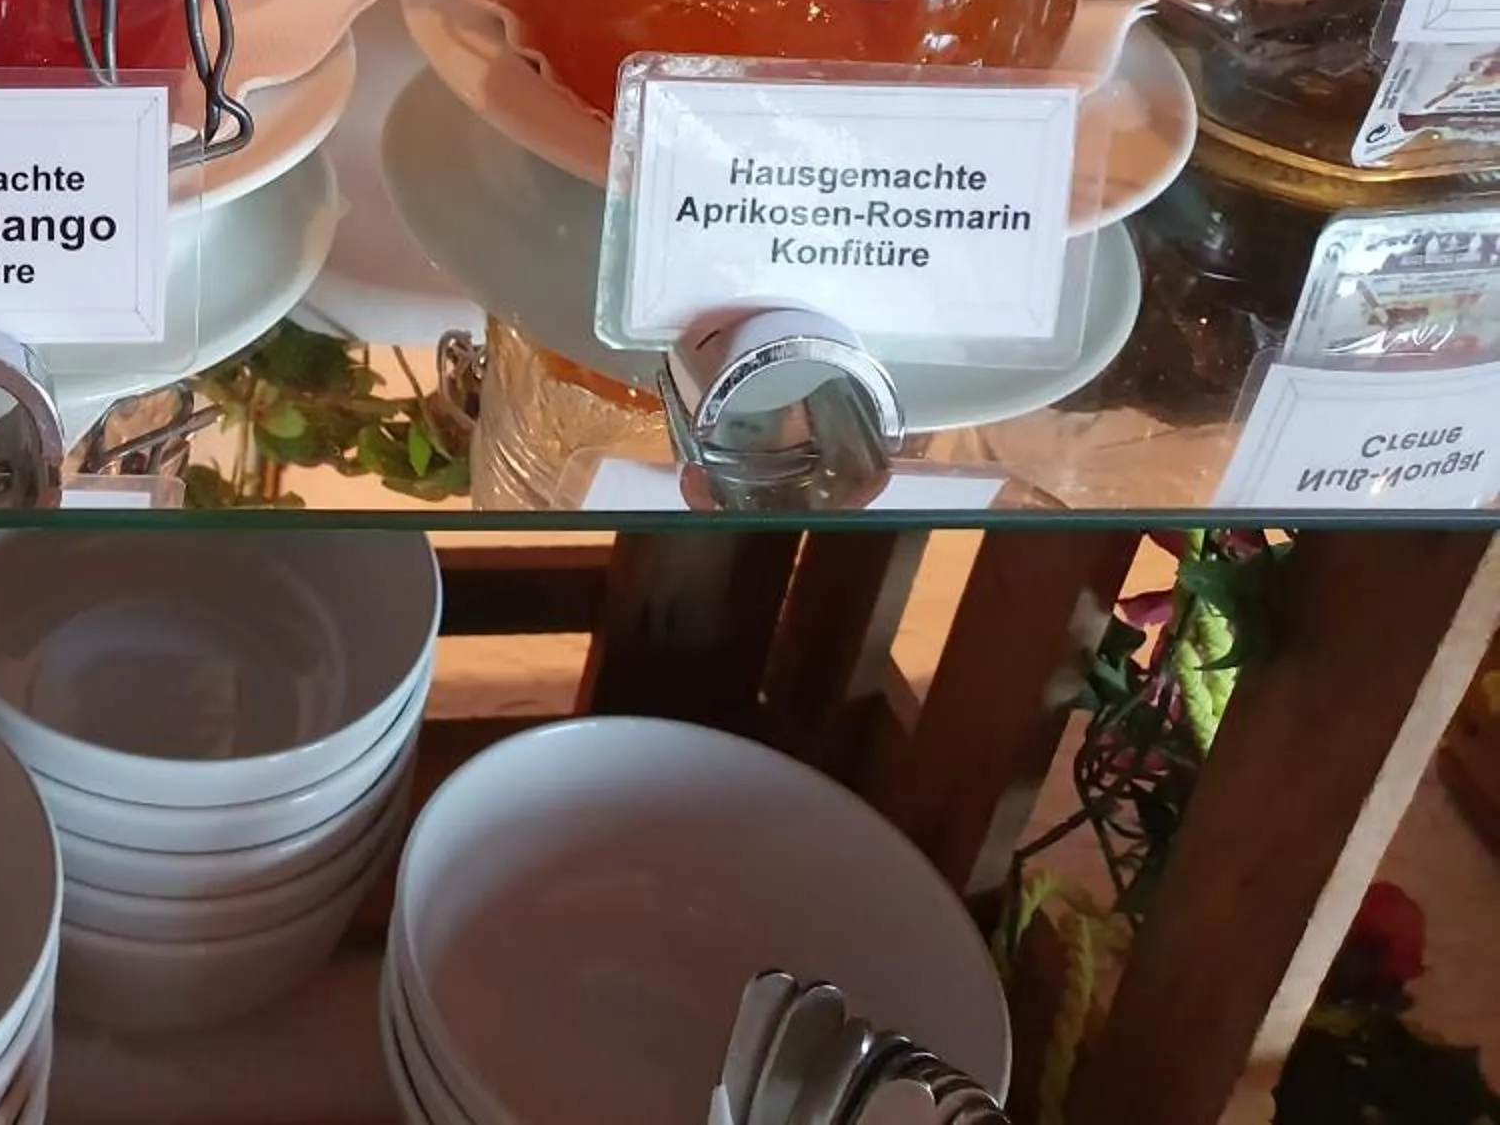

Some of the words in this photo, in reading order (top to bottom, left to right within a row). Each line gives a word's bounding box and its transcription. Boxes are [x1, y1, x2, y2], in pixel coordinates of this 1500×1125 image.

[729, 158, 987, 194] Hausgemachte
[675, 196, 1032, 232] Aprikosen-Rosmarin
[771, 237, 930, 268] Konfitüre
